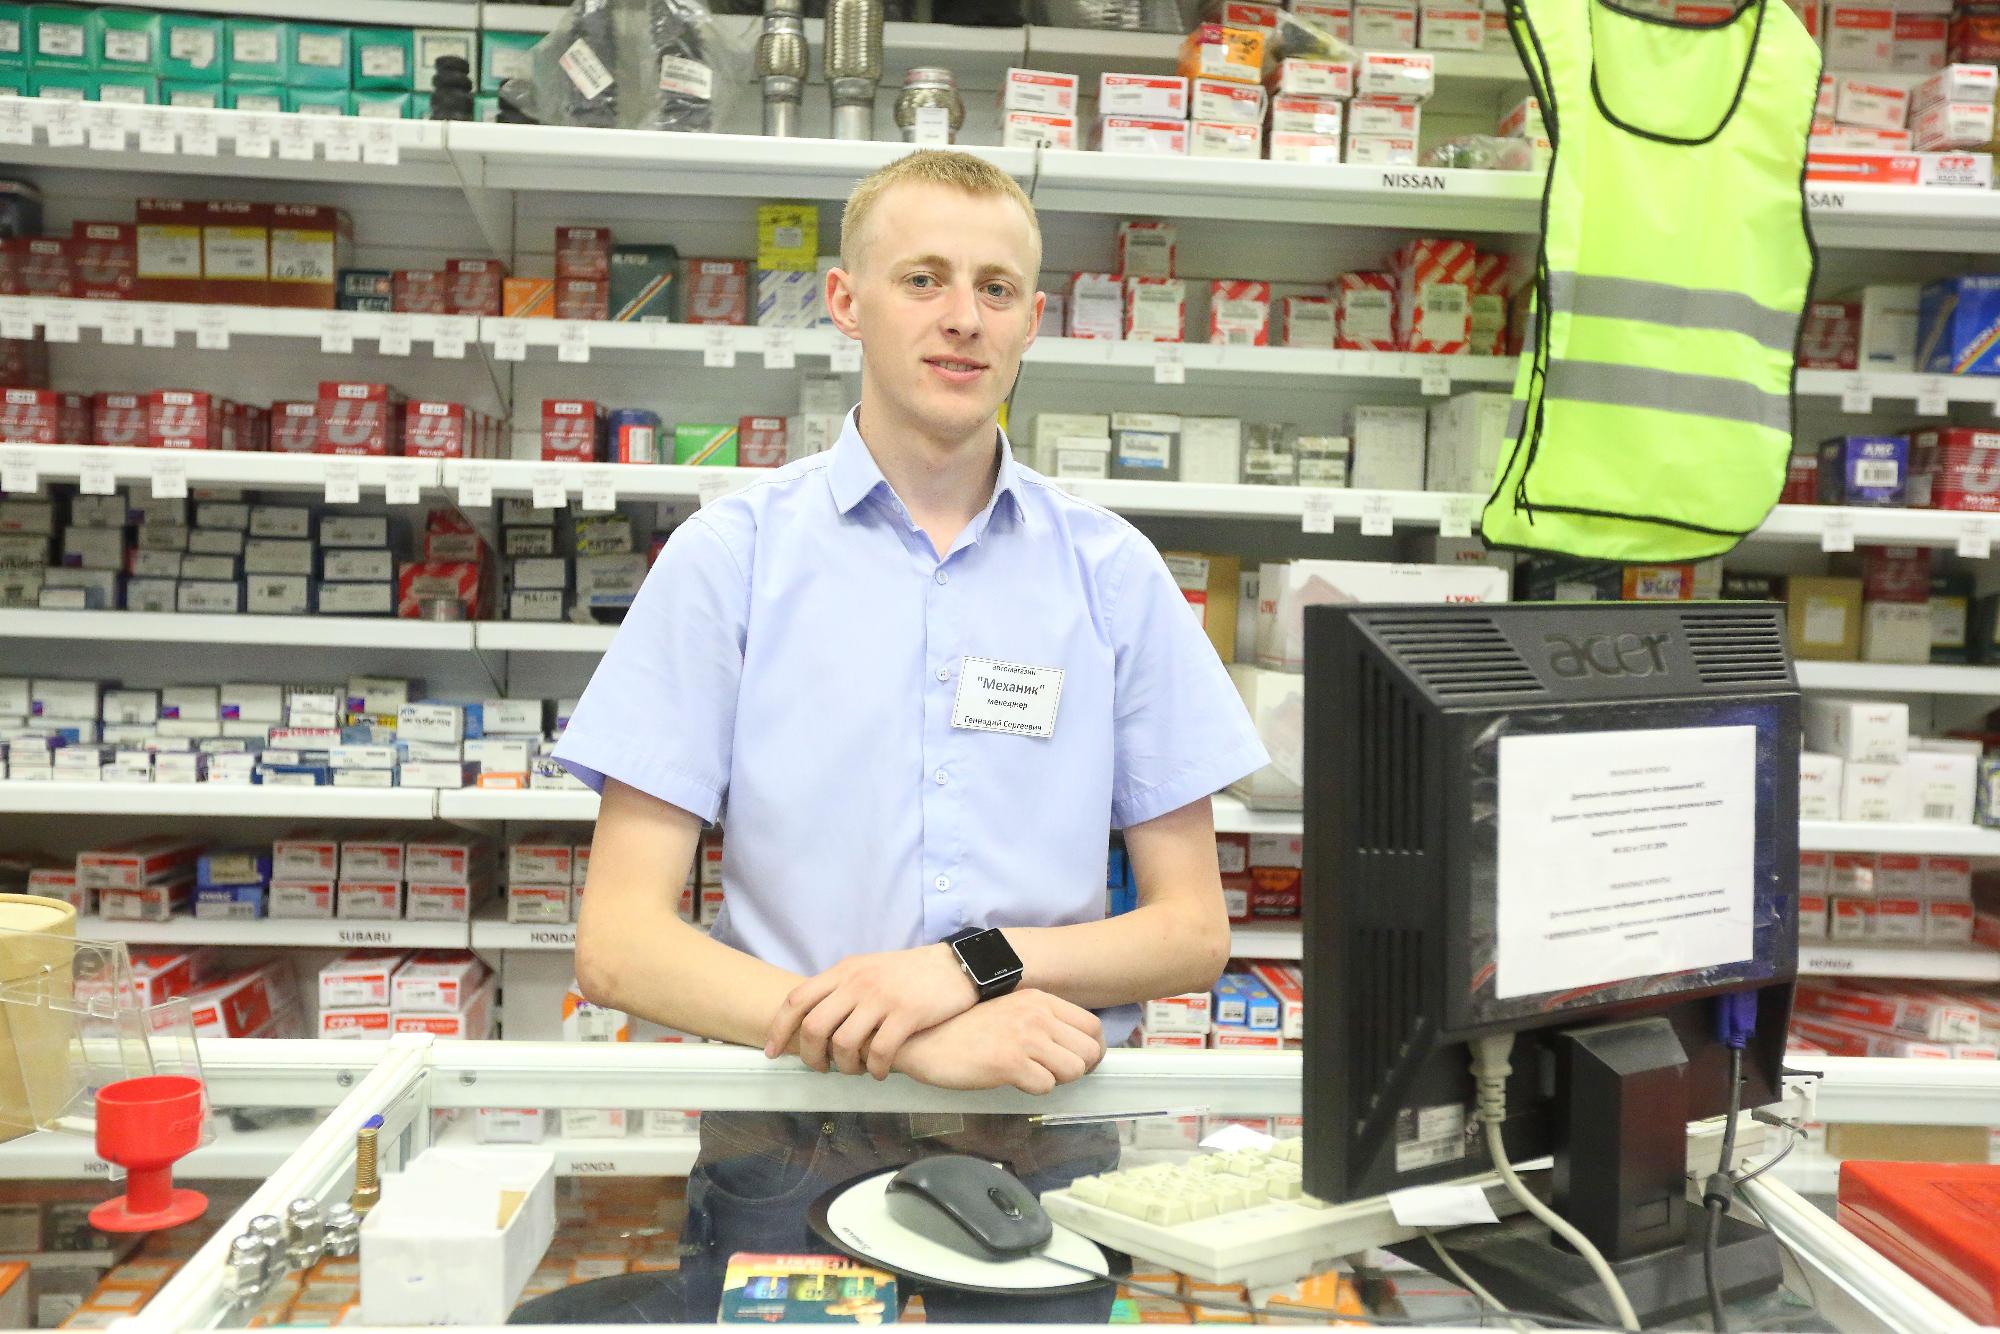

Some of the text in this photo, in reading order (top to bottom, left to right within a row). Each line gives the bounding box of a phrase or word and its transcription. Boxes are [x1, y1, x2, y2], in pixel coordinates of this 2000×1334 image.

[1382, 174, 1447, 189] NISSAN
[1809, 193, 1844, 208] SAN
[328, 400, 377, 445] U
[415, 416, 451, 447] U
[1544, 631, 1670, 678] acer
[992, 665, 1037, 676] автомагазин
[977, 676, 1045, 696] "Механик"
[987, 698, 1028, 710] менеджер
[964, 715, 1042, 731] Геннадий Сергеевич
[338, 930, 392, 943] SUBARU
[531, 932, 576, 943] HONDA
[84, 1162, 110, 1173] HON
[571, 1162, 616, 1172] HONDA
